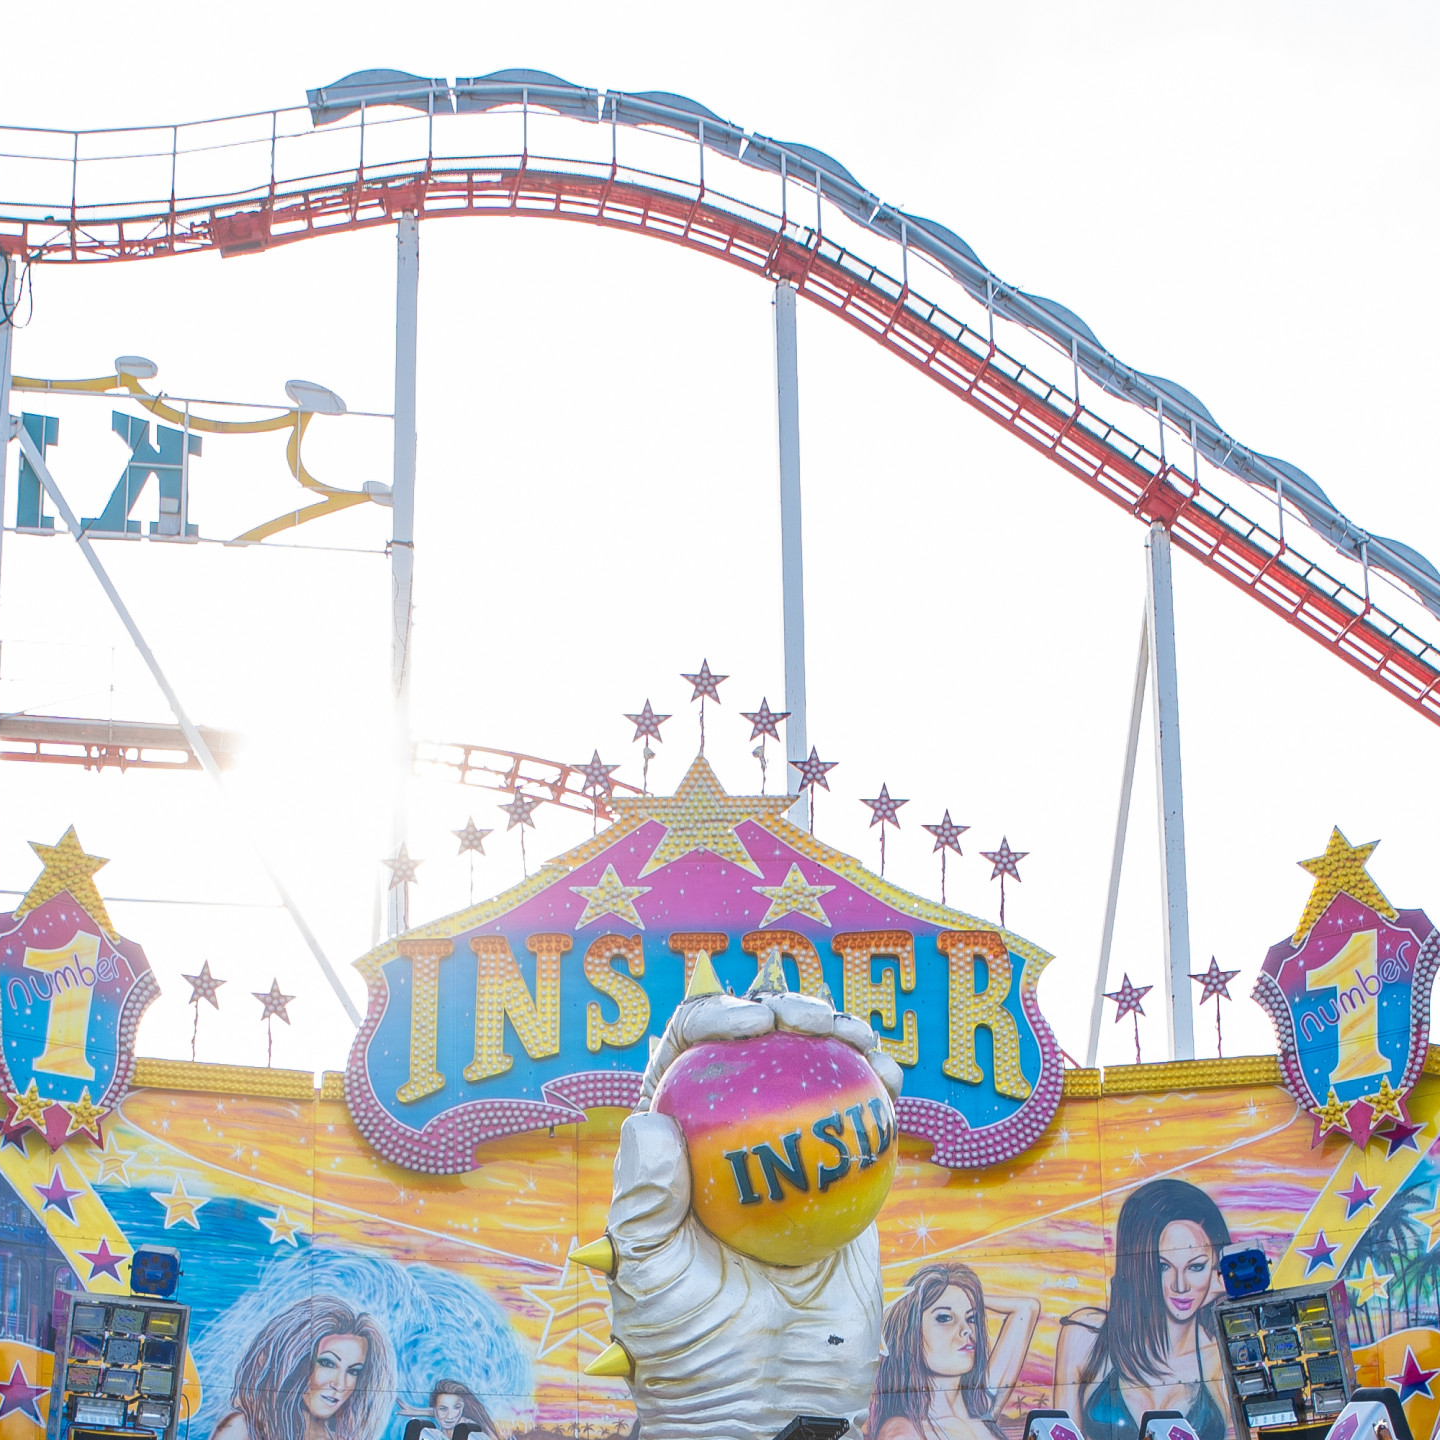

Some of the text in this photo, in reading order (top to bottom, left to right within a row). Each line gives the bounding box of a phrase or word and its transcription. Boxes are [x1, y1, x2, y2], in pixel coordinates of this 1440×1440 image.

[7, 953, 120, 1010] number
[23, 930, 101, 1081] 1
[1300, 941, 1411, 1042] number
[1306, 928, 1392, 1083] 1
